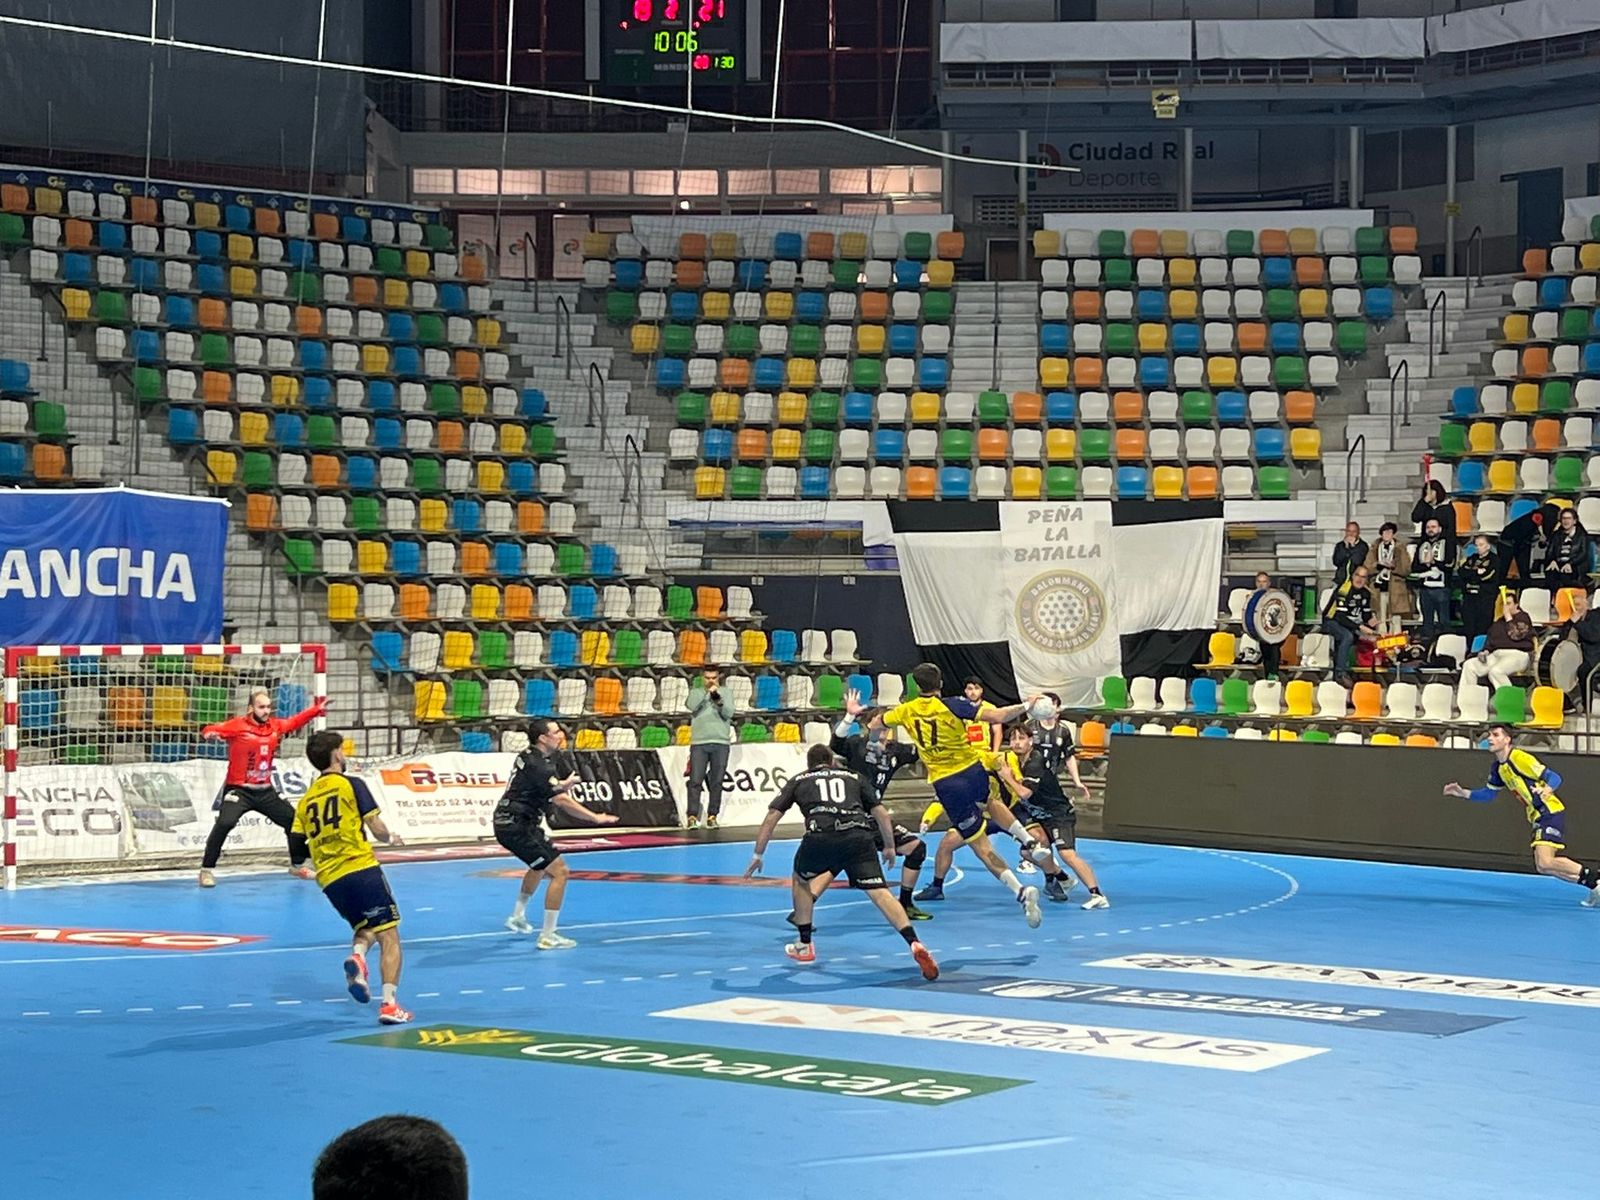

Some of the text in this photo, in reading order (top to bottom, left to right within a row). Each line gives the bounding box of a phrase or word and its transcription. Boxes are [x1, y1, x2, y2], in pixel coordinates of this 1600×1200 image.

[1068, 141, 1214, 161] Ciudad Ral
[1068, 170, 1161, 189] Deporte
[1027, 505, 1084, 524] PEÑA
[1044, 526, 1069, 542] LA
[1014, 543, 1102, 562] BATALLA
[0, 547, 197, 603] ANCHA
[1030, 576, 1090, 596] BALONMANO
[618, 775, 664, 801] MÁS
[720, 766, 788, 793] ea26
[815, 778, 847, 804] 10
[305, 795, 343, 839] 34
[928, 1019, 1270, 1058] nexus
[519, 1042, 973, 1100] Globalcaja
